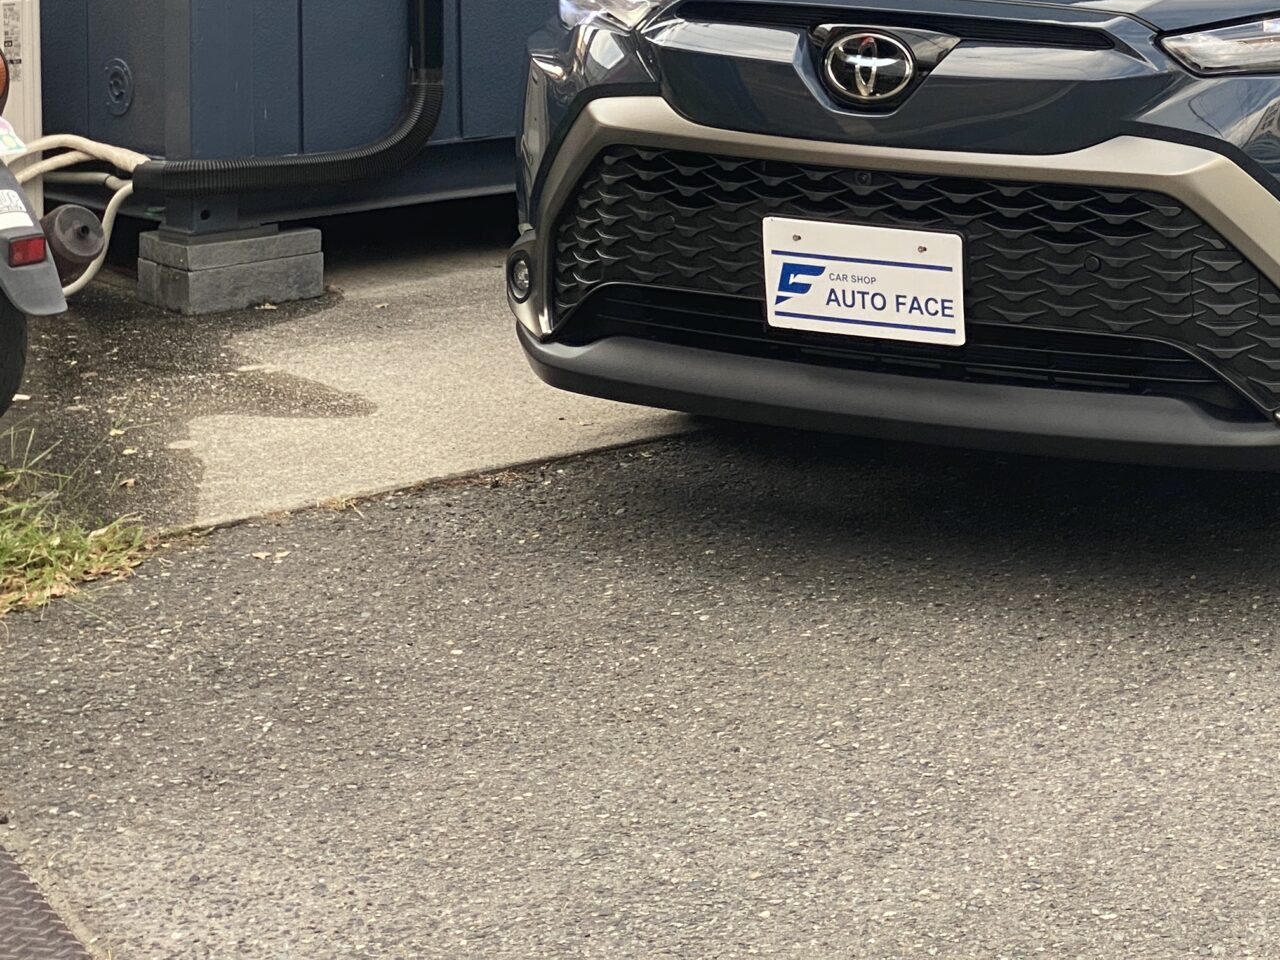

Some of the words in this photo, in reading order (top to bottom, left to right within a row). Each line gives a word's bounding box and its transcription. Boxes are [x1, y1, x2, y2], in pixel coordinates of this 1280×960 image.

[828, 272, 849, 283] CAR
[850, 274, 877, 285] SHOP
[825, 288, 887, 311] AUTO
[895, 294, 955, 318] FACE
